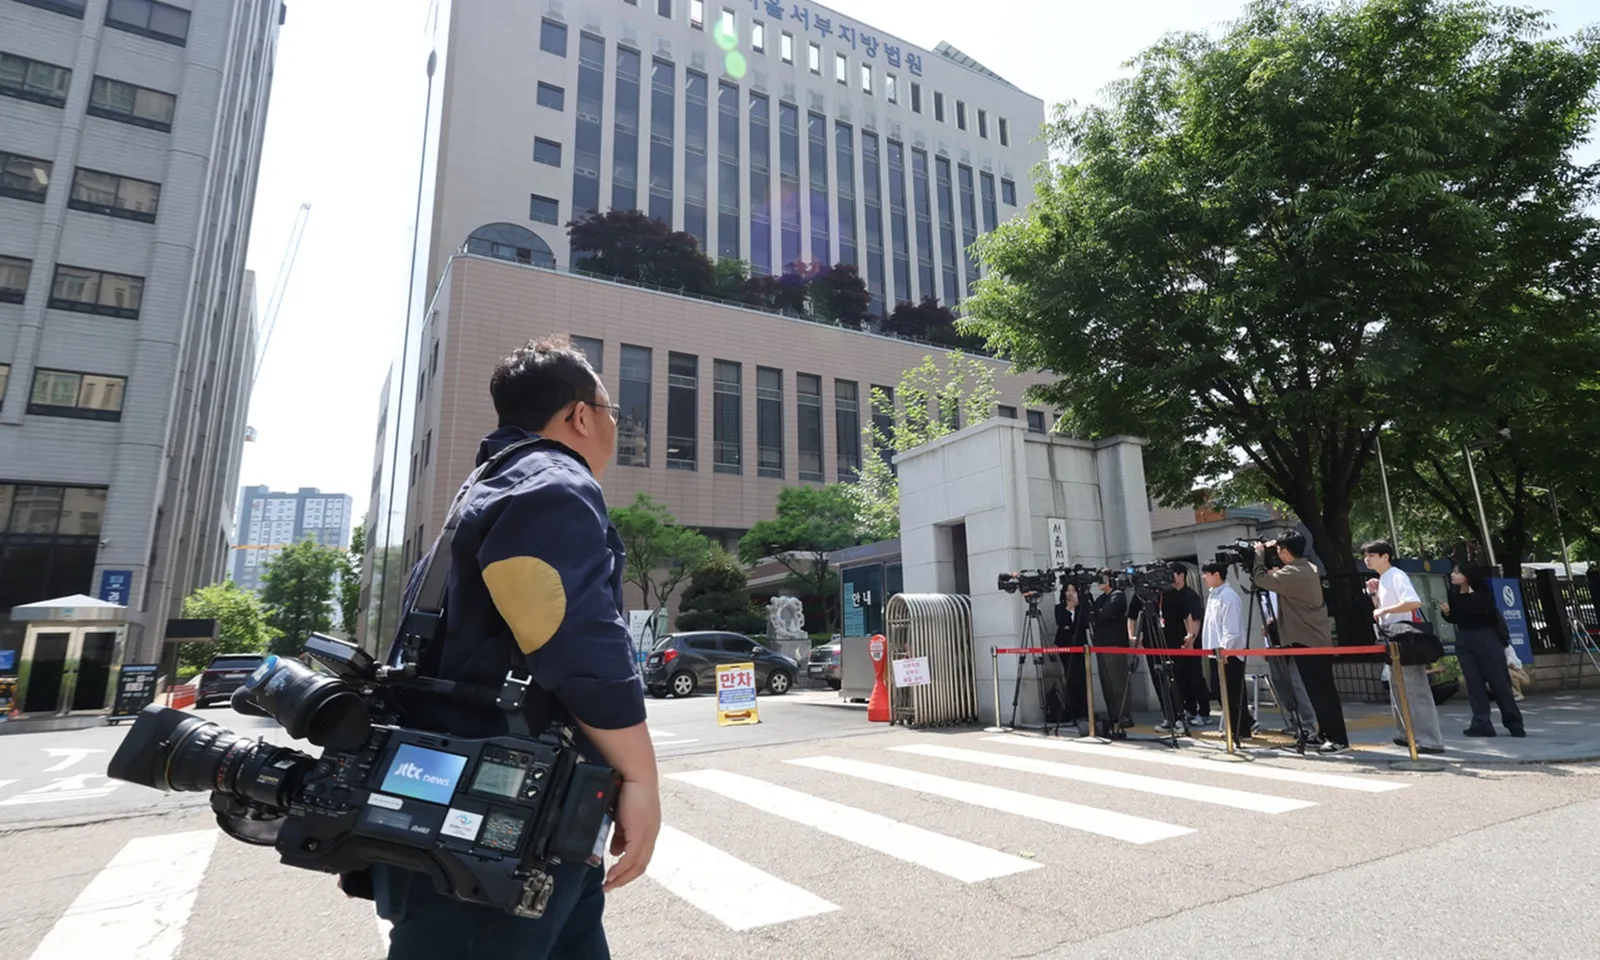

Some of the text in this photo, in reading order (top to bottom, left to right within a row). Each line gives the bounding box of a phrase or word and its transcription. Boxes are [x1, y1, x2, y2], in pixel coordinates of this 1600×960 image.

[749, 0, 922, 77] 울서부지방법원
[720, 671, 752, 688] 만차
[422, 774, 450, 787] news
